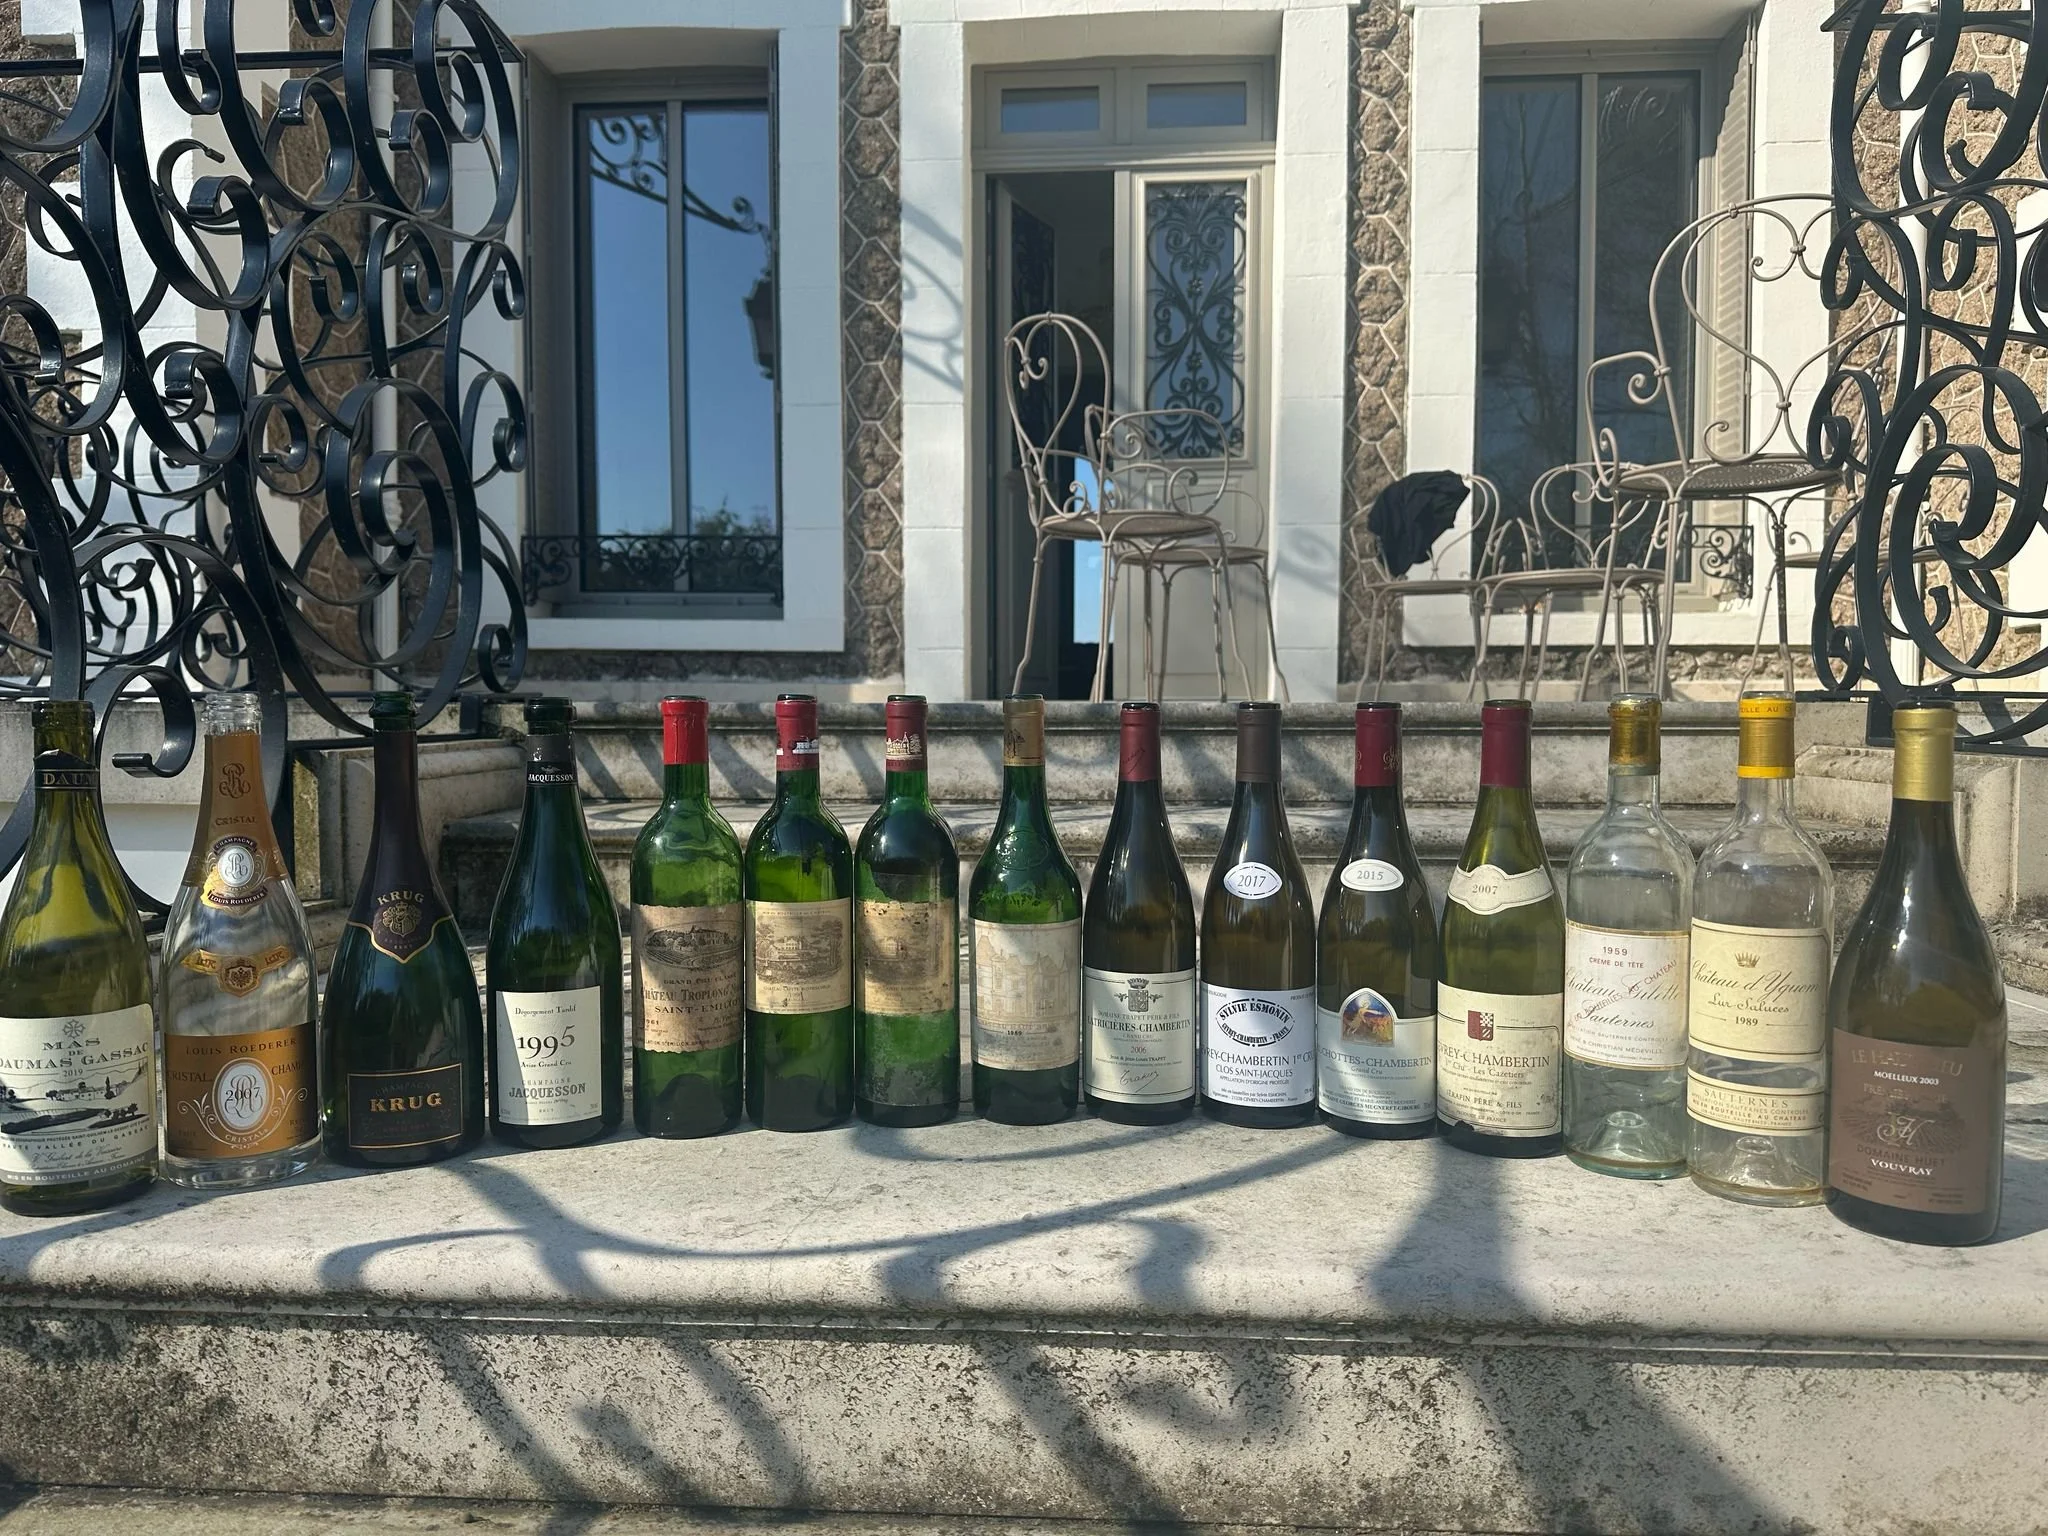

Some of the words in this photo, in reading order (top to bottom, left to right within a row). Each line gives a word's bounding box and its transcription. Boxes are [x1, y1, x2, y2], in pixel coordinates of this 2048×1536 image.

[528, 773, 573, 783] JACQUESSON
[215, 815, 257, 826] CRISTAL
[215, 837, 254, 849] CHAMPAGNE
[1238, 875, 1266, 887] 2017
[1357, 871, 1384, 880] 2015
[1472, 884, 1498, 895] 2007
[210, 895, 229, 905] LOUIS
[230, 893, 265, 905] ROEDERER
[377, 890, 424, 906] KRUG
[1603, 946, 1628, 956] 1959
[1628, 960, 1644, 968] TÊTE
[1644, 960, 1677, 985] CHATEAU
[1692, 960, 1739, 989] Château
[1744, 970, 1819, 1003] d'Yquem
[655, 999, 739, 1014] SAINT-EMILIO
[1220, 1003, 1247, 1021] SYLVIE
[1250, 1002, 1290, 1023] ESMONIN
[1577, 1000, 1655, 1028] Sauternes
[645, 1018, 660, 1026] 961
[1735, 1016, 1758, 1026] 1989
[1222, 1022, 1268, 1043] GEVREY-CHAMBERTIN
[1273, 1026, 1289, 1041] FRANCE
[43, 1038, 100, 1051] MAS
[186, 1047, 222, 1056] LOUIS
[230, 1038, 296, 1054] ROEDERER
[517, 1025, 576, 1059] 1995
[1588, 1041, 1623, 1052] CHRISTIAN
[81, 1042, 148, 1066] GASSAC
[1130, 1046, 1146, 1054] 2006
[1202, 1047, 1289, 1066] VREY-CHAMBERTIN
[1439, 1044, 1550, 1068] VREY-CHAMBERTIN
[538, 1060, 558, 1068] Grand
[1453, 1061, 1465, 1071] Cru
[1474, 1065, 1486, 1075] Les
[1488, 1068, 1526, 1079] Cazetiers
[64, 1069, 83, 1077] 2019
[1216, 1064, 1234, 1076] CLOS
[1236, 1066, 1293, 1079] SAINT-JACQUES
[1372, 1067, 1383, 1075] Cru
[522, 1077, 571, 1086] CHAMPAGNE
[1873, 1070, 1918, 1084] MOELLEUX
[1919, 1077, 1940, 1086] 2003
[226, 1086, 260, 1101] 2007
[509, 1083, 586, 1100] JACQUESSON
[1704, 1088, 1789, 1108] SAUTERNES
[370, 1092, 442, 1112] KRUG
[1506, 1101, 1522, 1109] FILS
[1725, 1102, 1767, 1114] SAUTERNES
[1711, 1105, 1751, 1118] BOUTEILLE
[1487, 1115, 1507, 1123] FRANCE
[37, 1140, 82, 1150] VALLÉE
[114, 1125, 149, 1140] GASSAC
[225, 1129, 264, 1142] CRISTAL
[1857, 1144, 1911, 1164] DOMAINE
[1915, 1156, 1945, 1168] HUET
[35, 1171, 89, 1181] BOUTEILLE
[94, 1167, 107, 1175] AU
[1871, 1159, 1933, 1176] VOUVRAY
